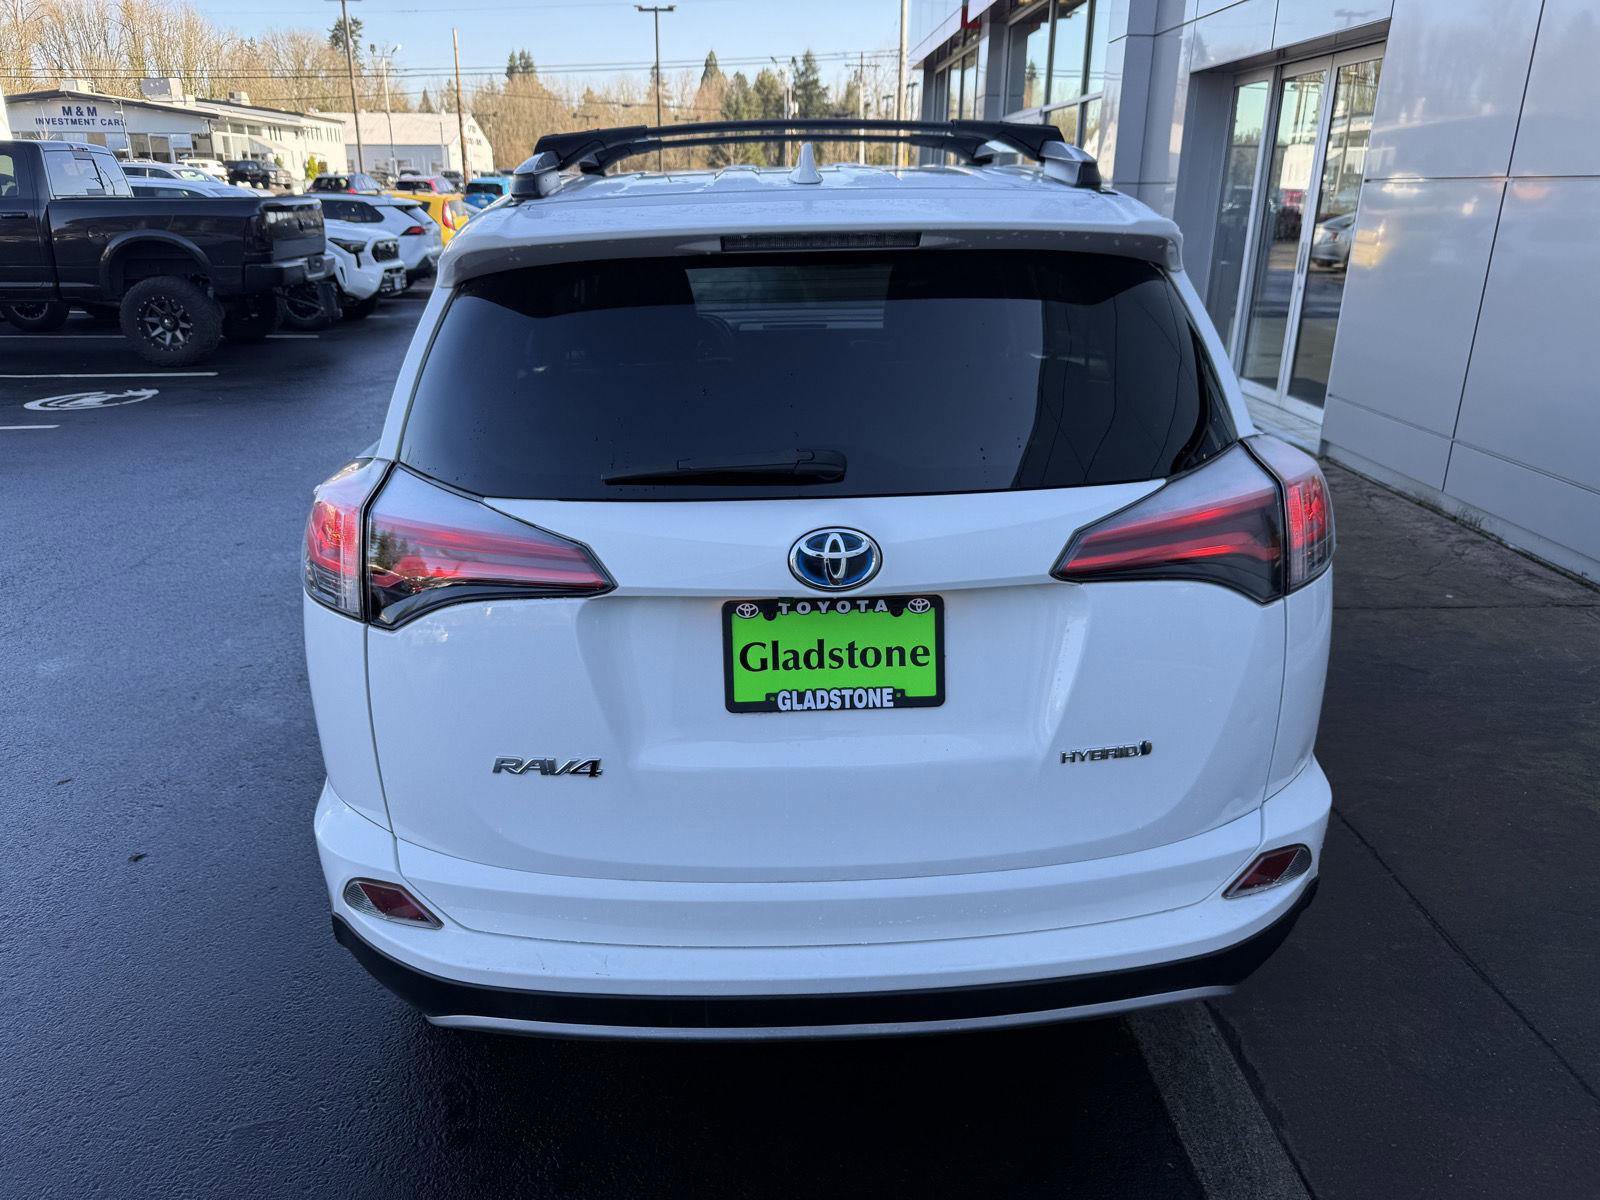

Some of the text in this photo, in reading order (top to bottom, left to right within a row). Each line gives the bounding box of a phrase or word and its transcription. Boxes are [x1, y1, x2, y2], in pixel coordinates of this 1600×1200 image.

[62, 106, 98, 117] M & M
[35, 117, 95, 126] INVESTMENT
[778, 600, 888, 615] TOYOTA
[739, 638, 931, 673] Gladstone
[777, 688, 894, 711] GLADSTONE
[1061, 745, 1138, 763] HYBRID
[493, 756, 603, 777] RAV4
